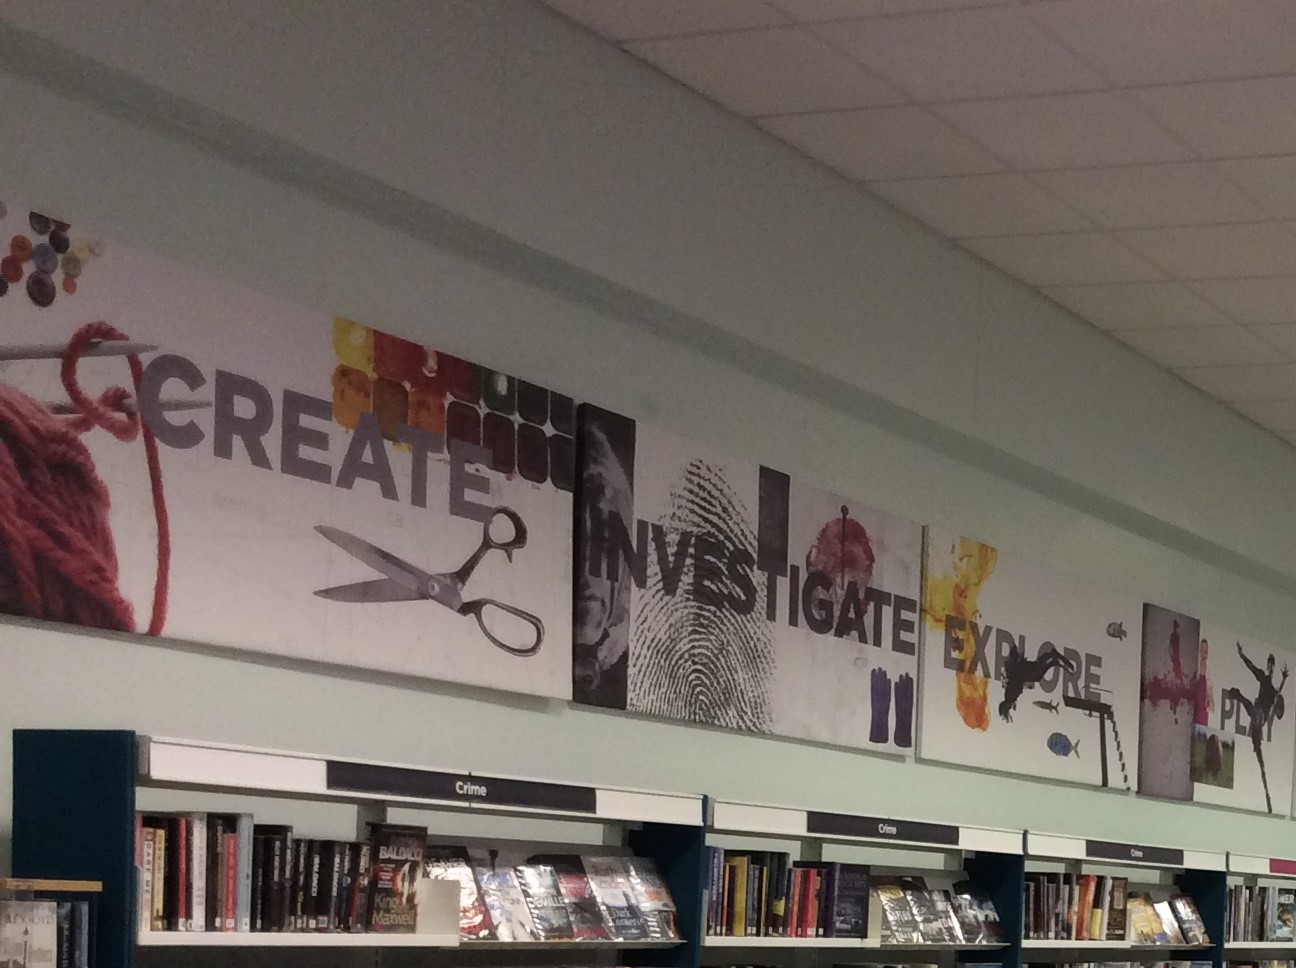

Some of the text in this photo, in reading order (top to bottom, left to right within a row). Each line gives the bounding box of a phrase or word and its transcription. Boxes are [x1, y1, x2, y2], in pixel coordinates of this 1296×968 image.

[138, 353, 495, 526] CREATE
[589, 508, 917, 657] INVESTIGATE
[455, 782, 487, 798] Crime
[878, 824, 897, 835] Crime
